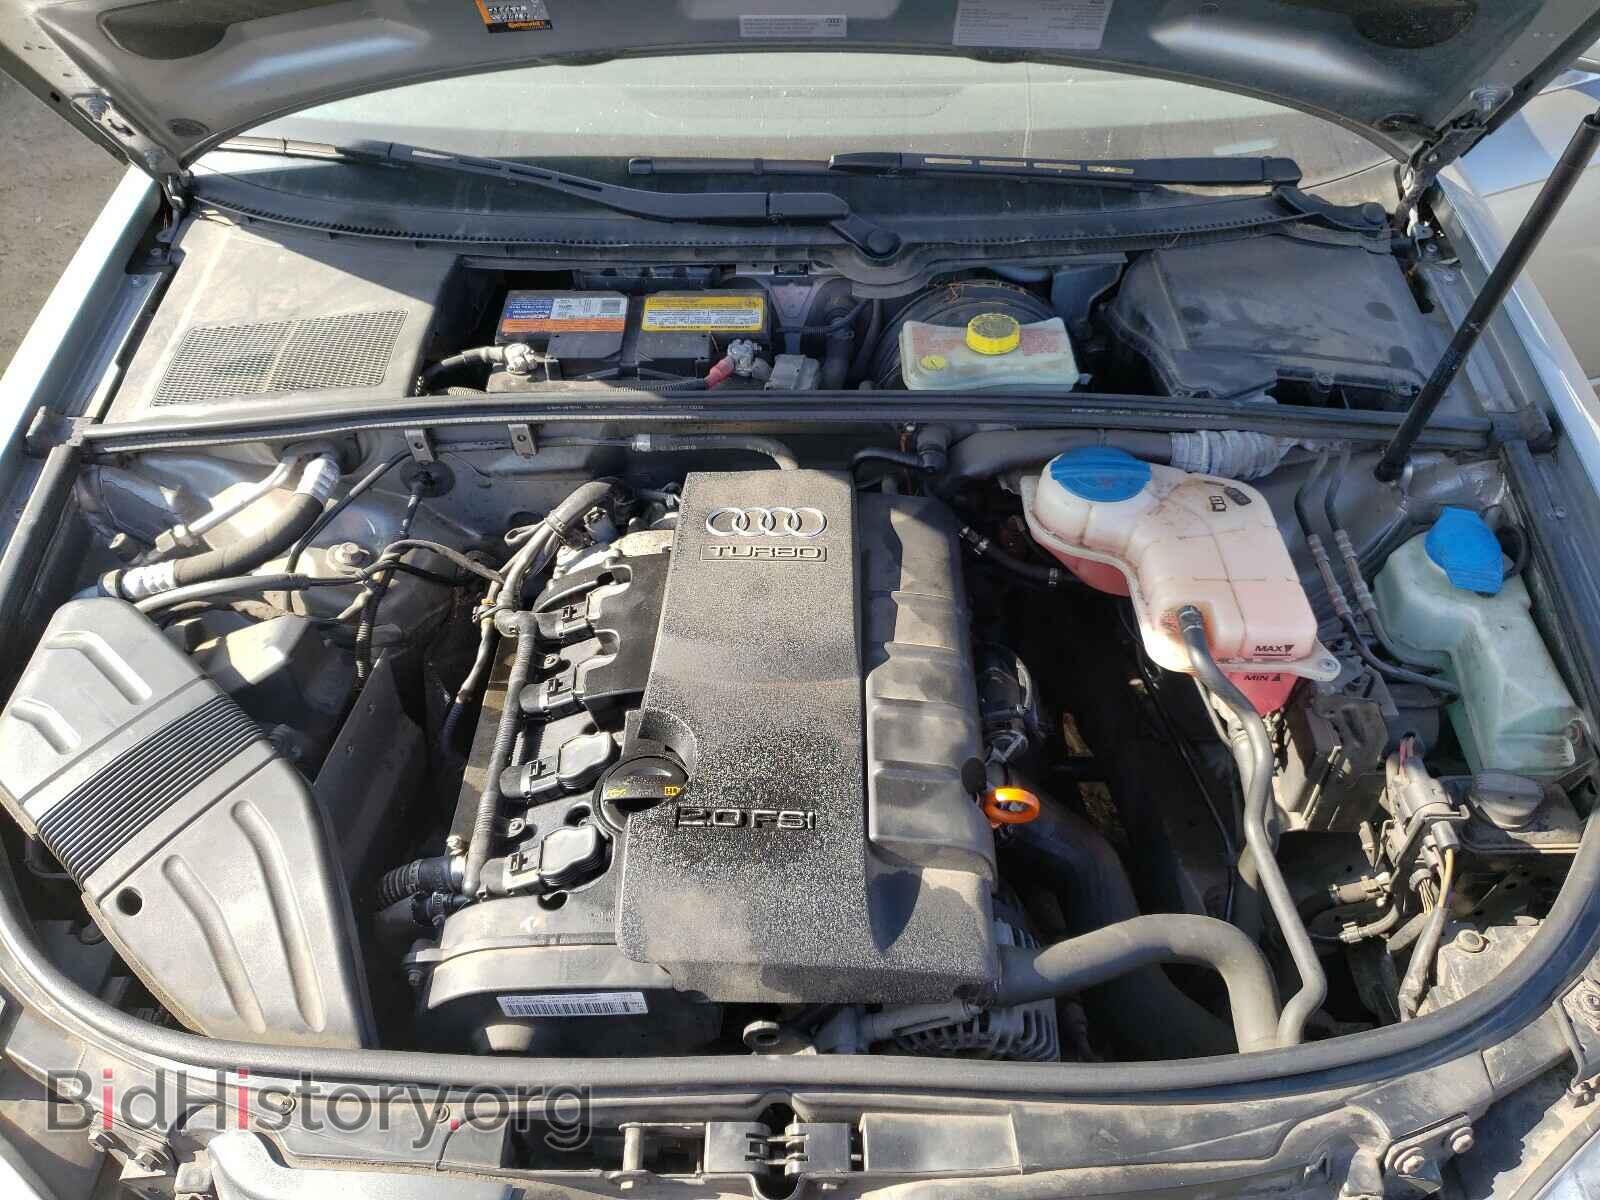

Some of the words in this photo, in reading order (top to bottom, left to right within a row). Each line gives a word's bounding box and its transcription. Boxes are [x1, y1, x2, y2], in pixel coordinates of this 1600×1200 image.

[710, 546, 821, 558] TURBO
[677, 808, 748, 827] 2.0
[751, 809, 816, 830] FSI
